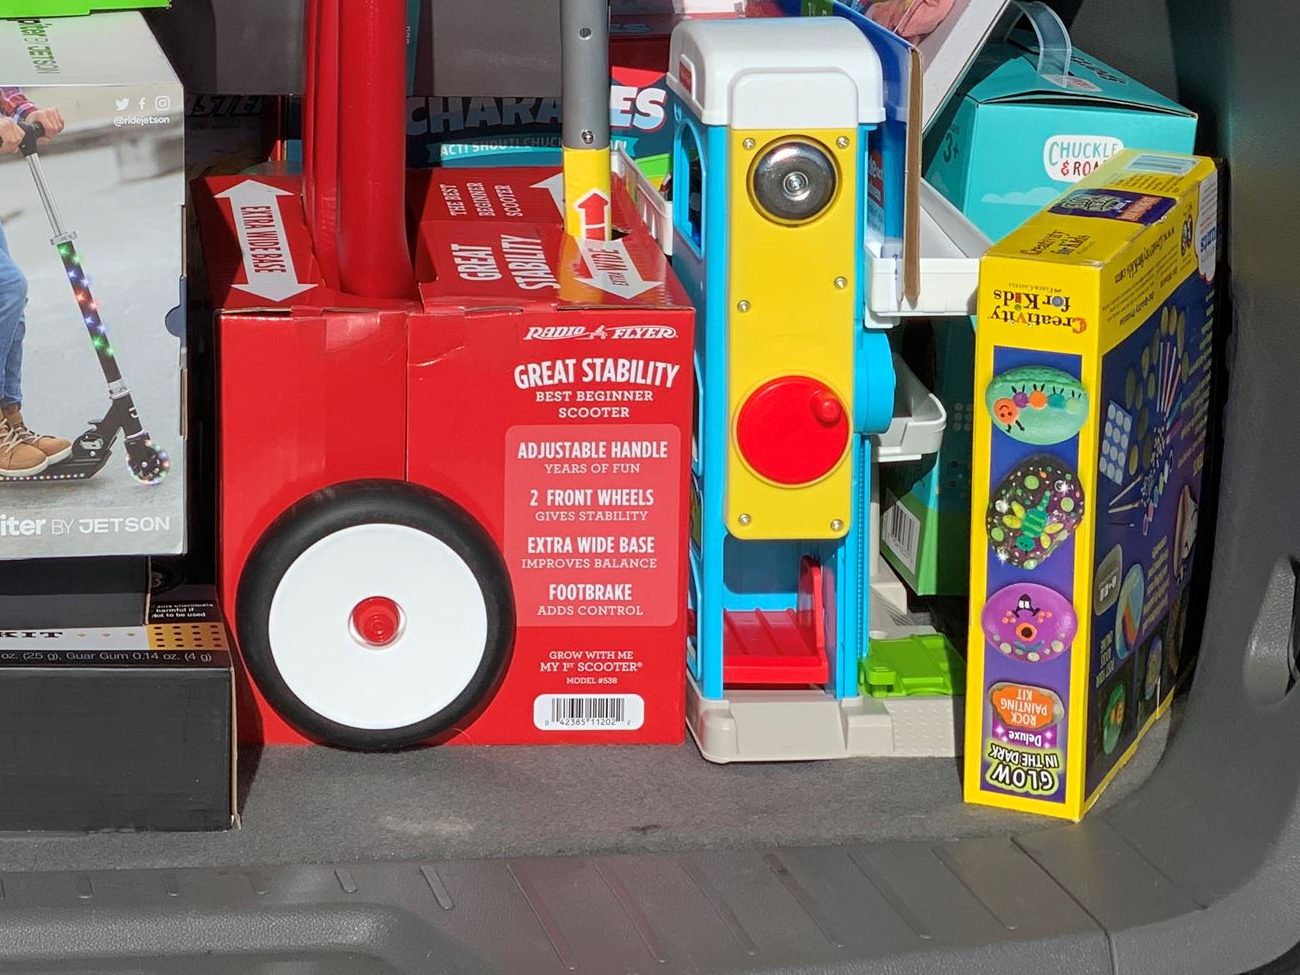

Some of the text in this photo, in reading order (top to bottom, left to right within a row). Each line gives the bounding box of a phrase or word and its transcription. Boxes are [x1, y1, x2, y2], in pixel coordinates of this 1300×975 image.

[113, 115, 171, 127] @ridejetson
[439, 137, 523, 157] ACT! SHOUT!
[1049, 140, 1120, 167] CHUCKLE
[439, 183, 468, 216] THE BEST
[466, 181, 496, 217] BEGINNER
[494, 184, 524, 217] SCOOTER
[241, 205, 287, 273] EXTRA WIDE BASE
[450, 243, 503, 282] GREAT
[500, 233, 562, 290] STABILITY
[588, 248, 629, 287] EXTRA WIDE
[993, 289, 1071, 313] for Kids
[989, 305, 1088, 334] Creativity
[523, 325, 679, 340] RADIO FLYER
[513, 357, 680, 389] GREAT STABILITY
[535, 390, 653, 402] BEST BEGINNER
[557, 407, 630, 418] SCOOTER
[516, 440, 668, 459] ADJUSTABLE HANDLE
[544, 462, 641, 474] YEARS OF FUN
[529, 488, 654, 507] 2 FRONT WHEELS
[535, 510, 648, 521] GIVES STABILITY
[50, 518, 74, 535] BY
[78, 516, 171, 534] JETSON
[527, 536, 655, 554] EXTRA WIDE BASE
[521, 558, 658, 569] IMPROVES BALANCE
[549, 584, 632, 601] FOOTBRAKE
[537, 605, 643, 616] ADDS CONTROL
[549, 651, 634, 660] GROW WITH ME
[540, 662, 559, 672] MY
[1015, 689, 1033, 701] KIT
[1000, 697, 1048, 714] PAINTING
[1010, 711, 1037, 726] ROCK
[1008, 730, 1042, 746] Deluxe
[989, 744, 1058, 768] IN THE DARK
[992, 763, 1053, 790] GLOW
